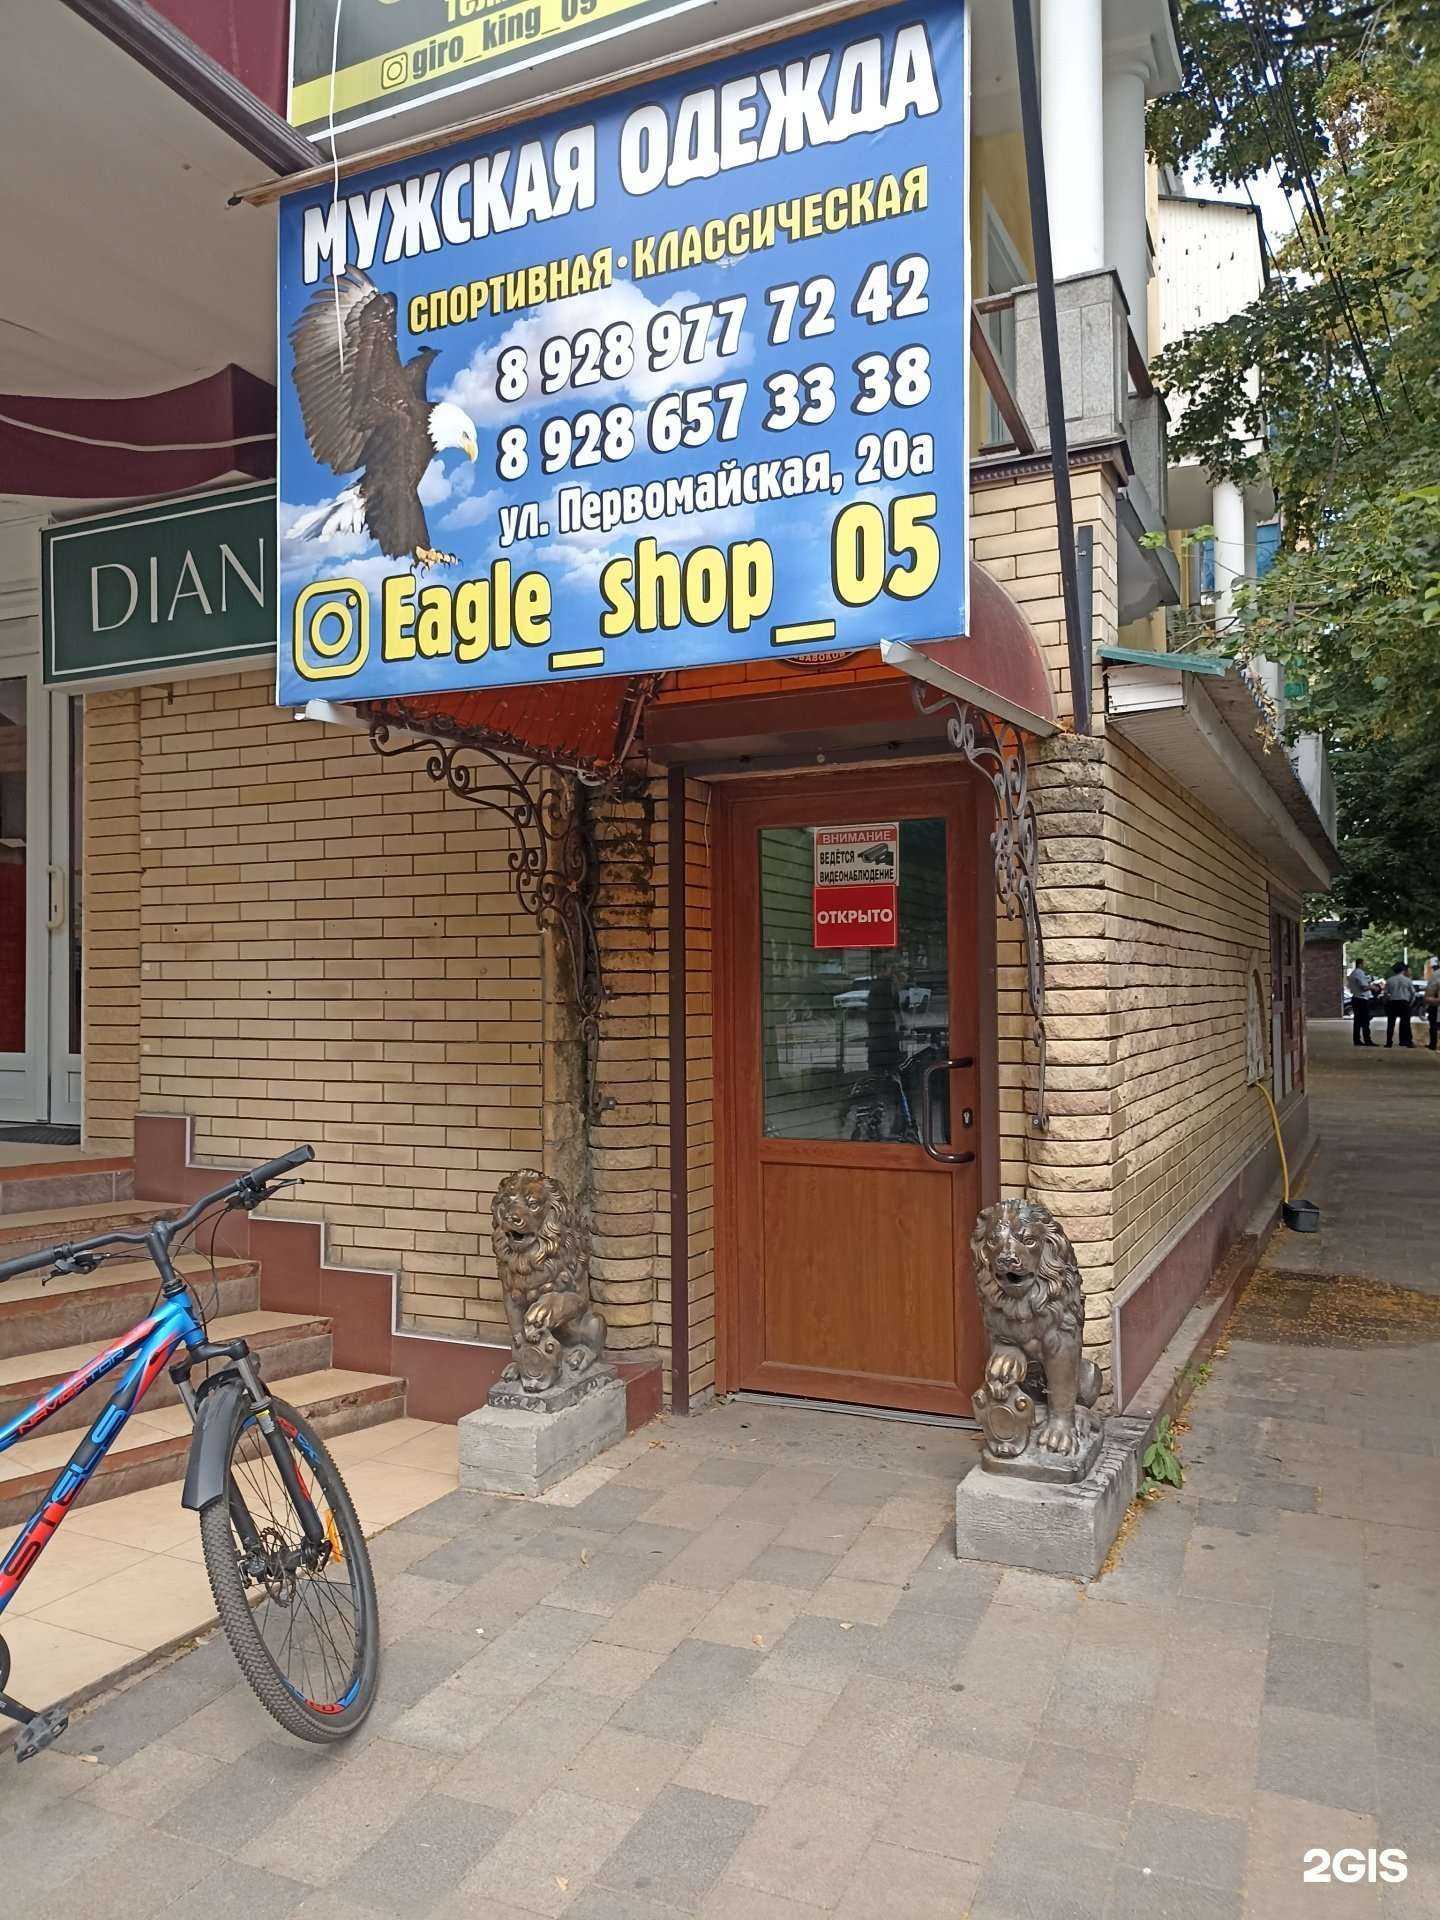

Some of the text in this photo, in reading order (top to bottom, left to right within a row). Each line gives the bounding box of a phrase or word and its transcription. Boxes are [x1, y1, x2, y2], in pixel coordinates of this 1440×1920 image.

[302, 22, 942, 285] МУЖСКАЯ ОДЕЖДА
[408, 164, 929, 334] СПОРТИВНАЯ КЛАССИЧЕСКАЯ
[497, 253, 930, 402] 8 928 977 72 42
[497, 344, 932, 481] 8 928 657 33 38
[499, 427, 935, 547] ул. Первомайская, 20а
[820, 868, 894, 884] ВИДЕОНАБЛЮДЕНИЕ
[822, 831, 891, 844] ВНИМАНИЕ
[817, 908, 893, 924] ОТКРЫТО
[3, 1404, 128, 1581] STELS
